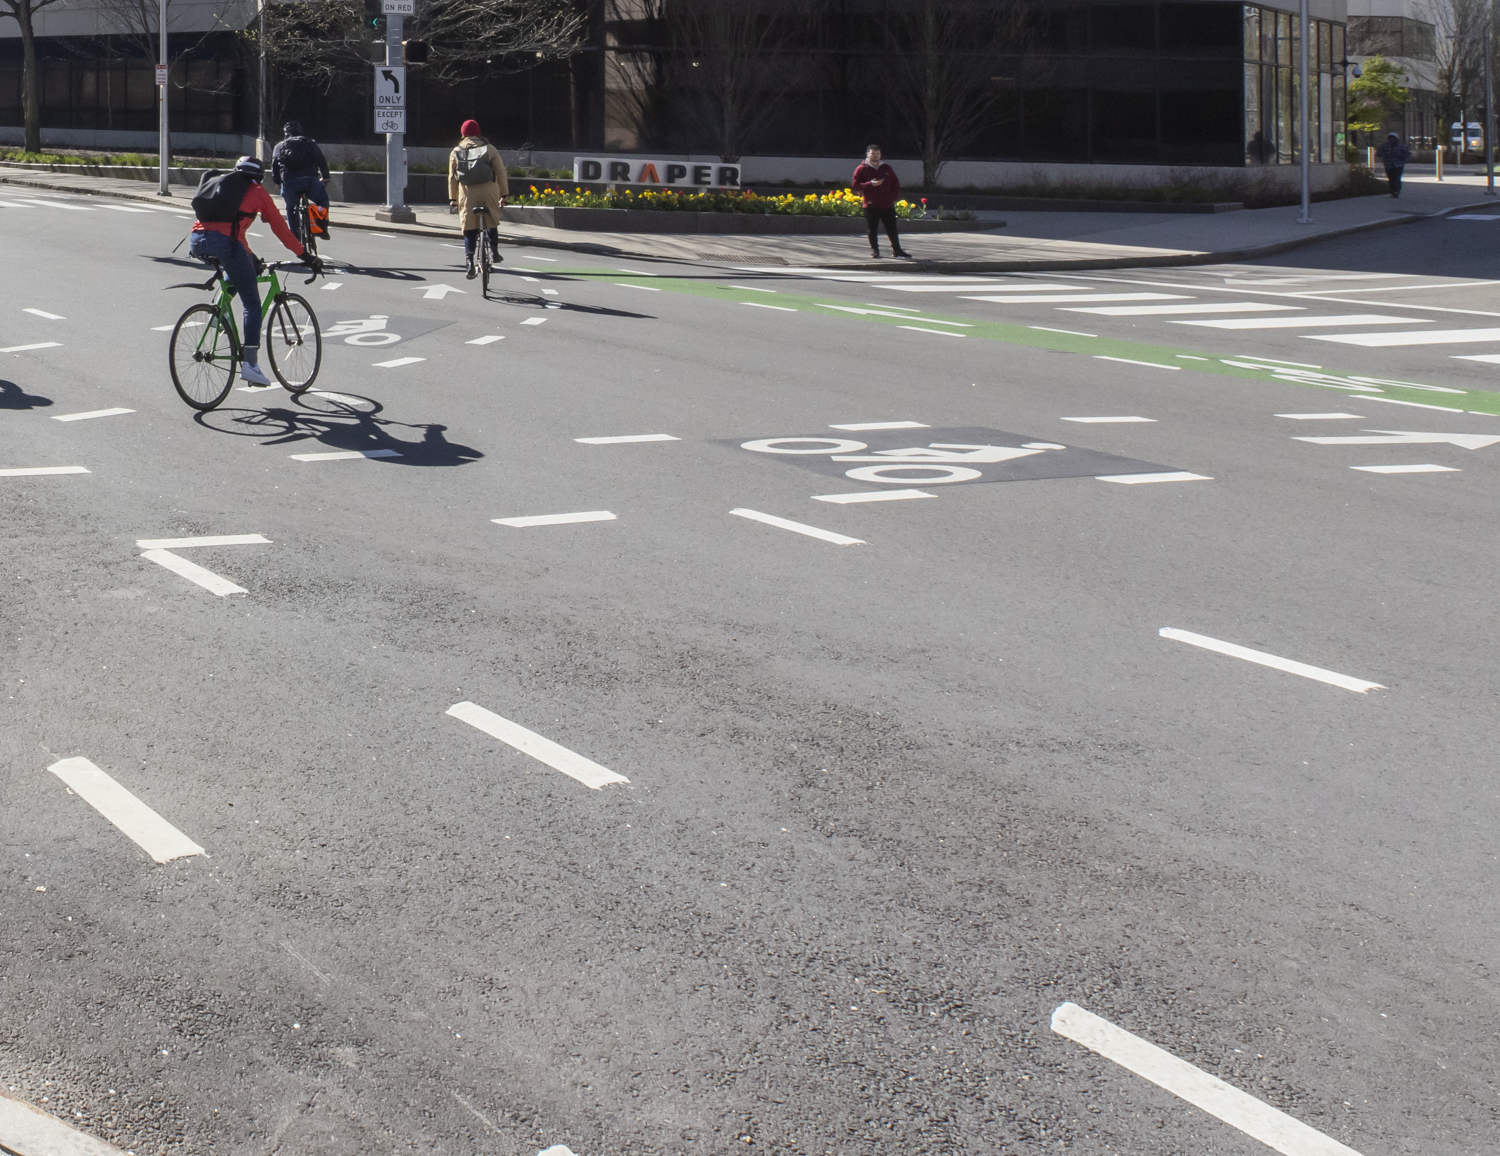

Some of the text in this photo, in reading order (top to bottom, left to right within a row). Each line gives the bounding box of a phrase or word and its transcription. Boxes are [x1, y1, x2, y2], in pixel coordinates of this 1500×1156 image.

[397, 4, 412, 12] RED
[378, 95, 402, 104] ONLY
[377, 110, 403, 118] EXCEPT
[581, 160, 740, 187] DRAPER
